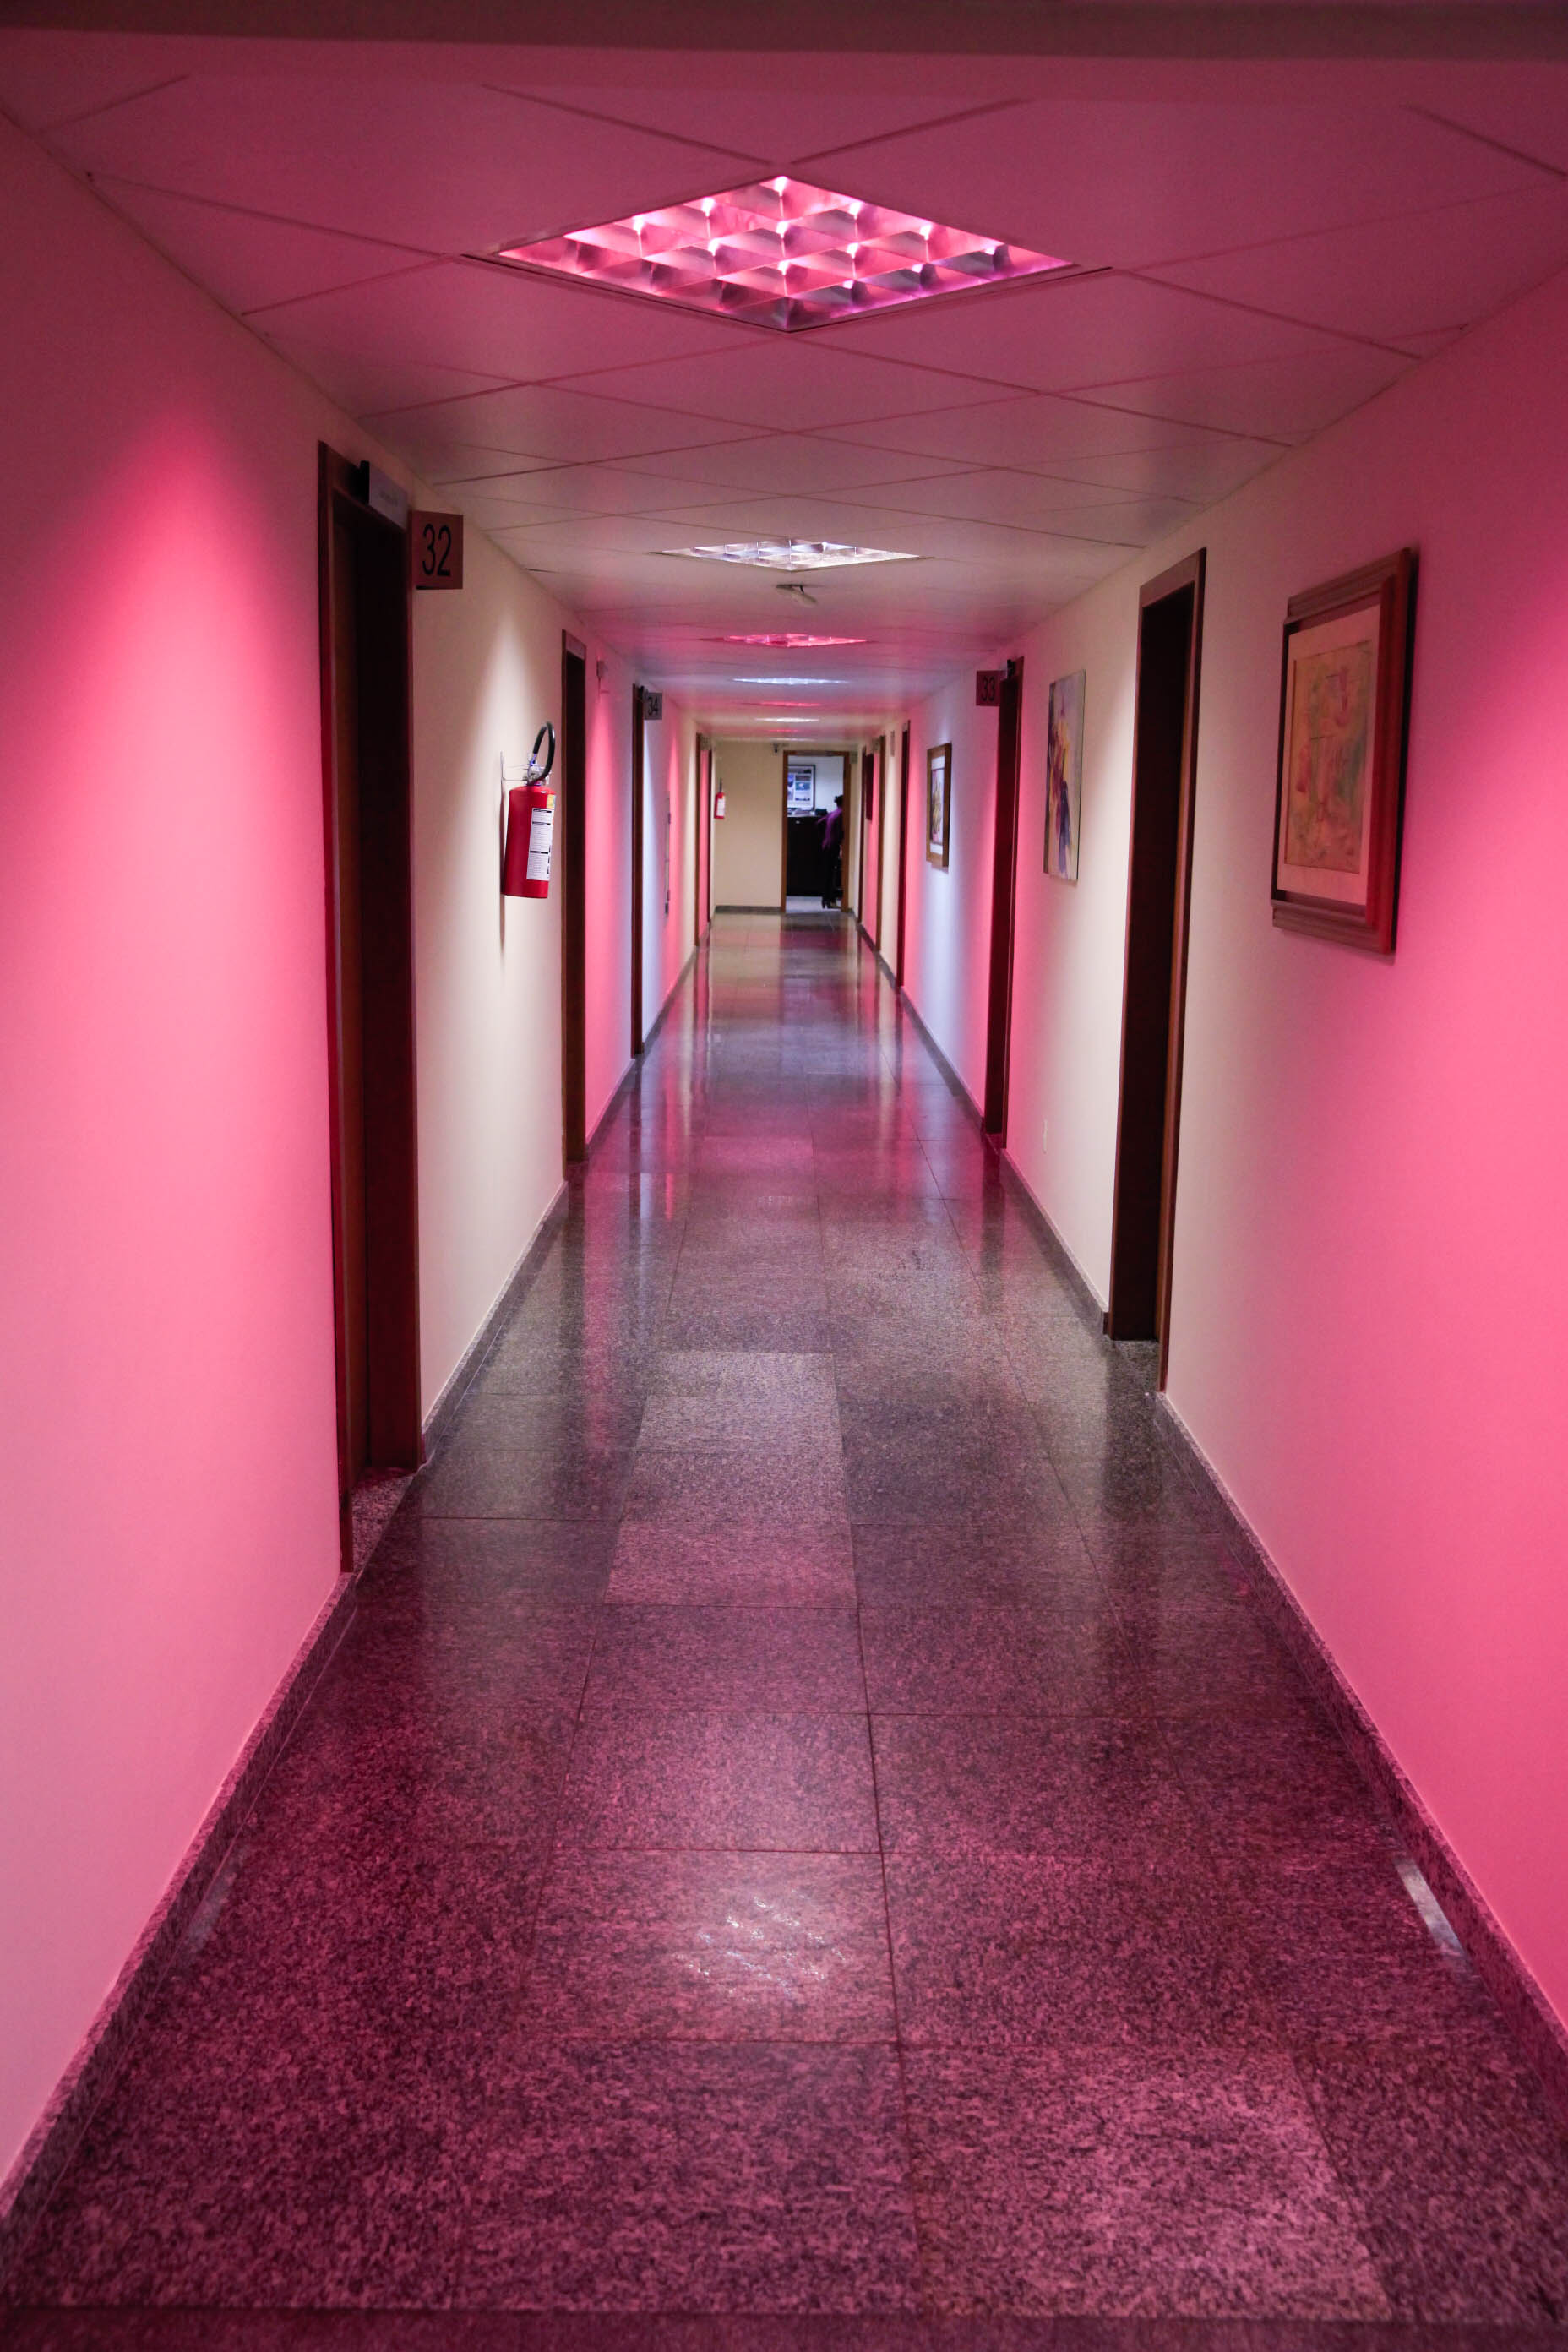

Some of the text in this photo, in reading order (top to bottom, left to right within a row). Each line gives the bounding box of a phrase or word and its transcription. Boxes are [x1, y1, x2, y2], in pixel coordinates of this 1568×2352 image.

[422, 523, 452, 576] 32
[980, 675, 995, 702] 33
[648, 695, 659, 716] 34
